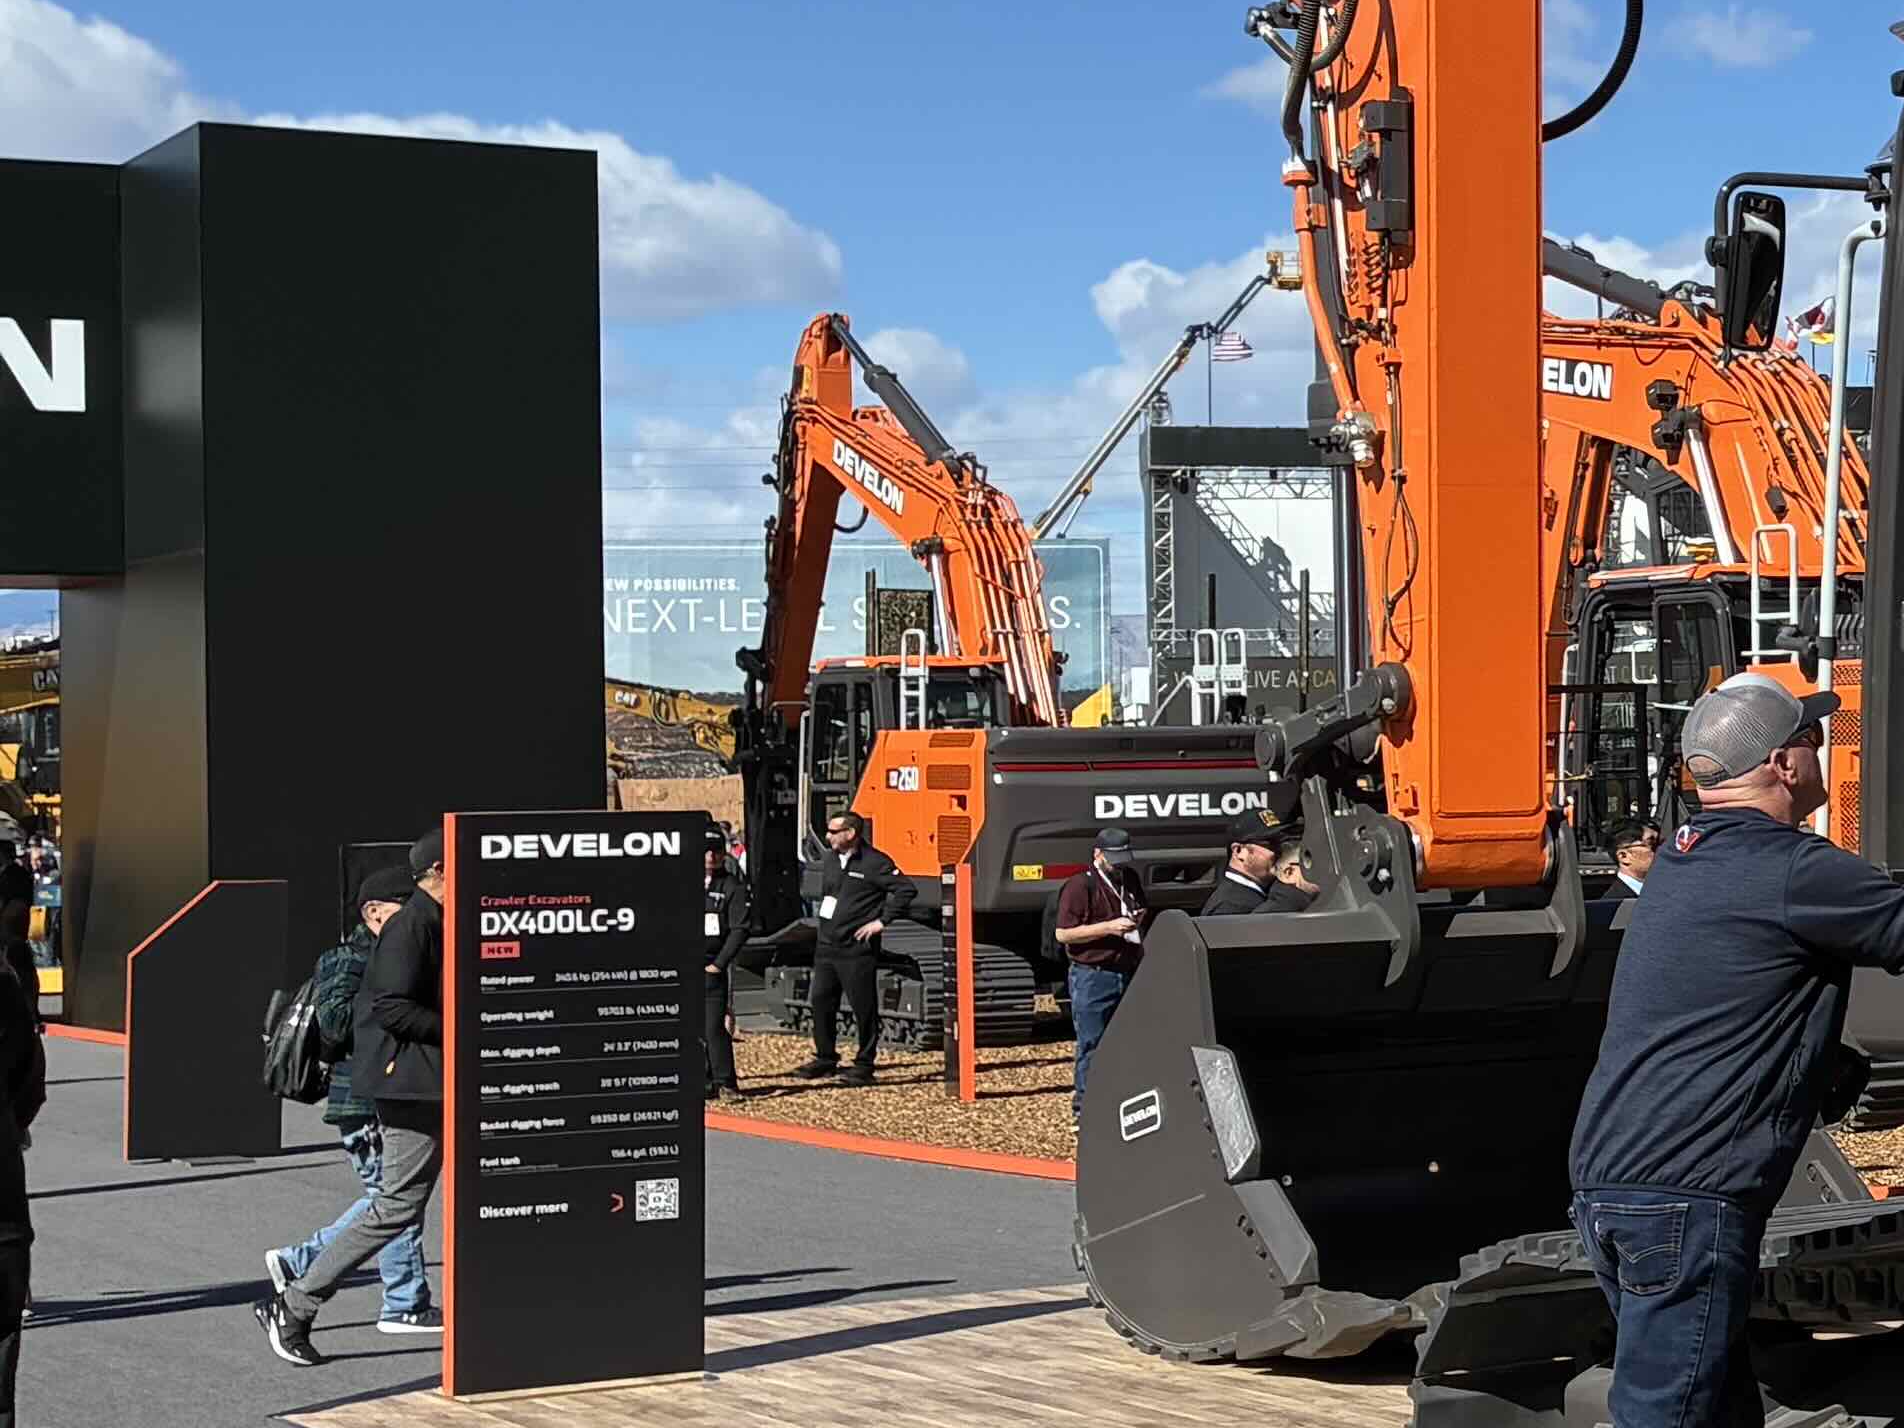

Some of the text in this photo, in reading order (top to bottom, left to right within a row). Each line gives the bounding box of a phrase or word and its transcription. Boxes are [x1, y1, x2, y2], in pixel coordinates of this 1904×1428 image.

[1542, 357, 1613, 400] ELON
[832, 437, 904, 517] DEVELON
[633, 577, 740, 592] POSSIBILITIES.
[33, 668, 60, 691] CA
[898, 766, 919, 791] 260
[1094, 791, 1268, 819] DEVELON
[480, 831, 681, 859] DEVELON
[480, 894, 592, 907] Crawler Excavators
[480, 908, 635, 936] DX400LC-9
[487, 946, 514, 955] NEW
[479, 1202, 569, 1219] Discover more
